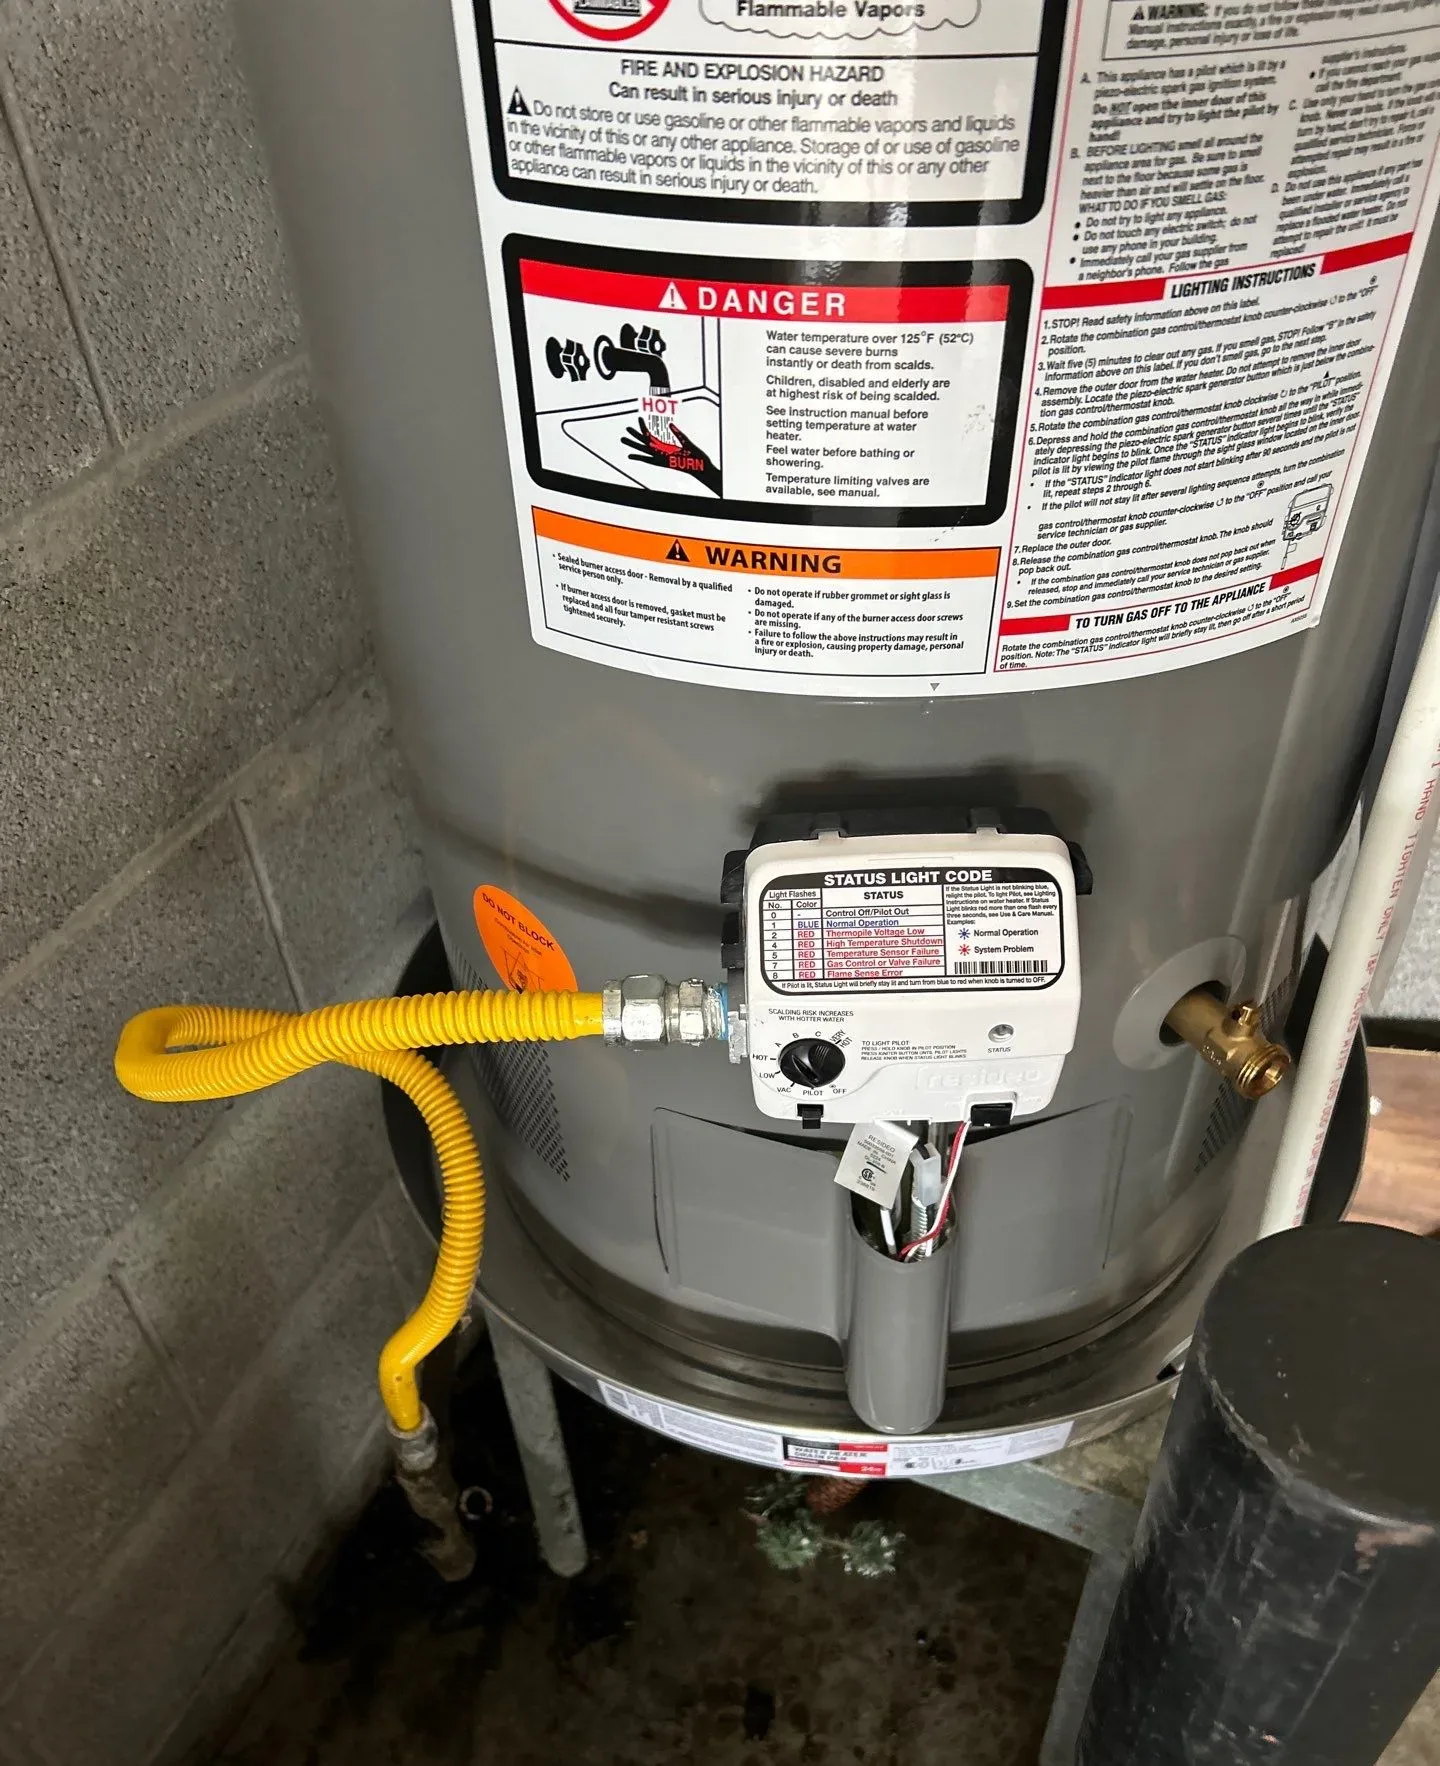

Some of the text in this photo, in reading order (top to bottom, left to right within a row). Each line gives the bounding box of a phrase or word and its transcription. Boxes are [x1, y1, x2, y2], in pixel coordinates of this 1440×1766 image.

[736, 0, 925, 20] Flammable Vapors
[621, 60, 884, 81] FIRE AND EXPLOSION HAZARD
[608, 82, 897, 109] Can result in serious injury or death
[1171, 262, 1316, 299] LIGHTING INSTRUCTIONS
[698, 286, 846, 317] DANGER
[766, 330, 973, 345] Water temperature over 125°F (52°C)
[766, 345, 898, 356] can cause severe burns
[766, 357, 934, 370] instantly or death from scalds.
[765, 375, 815, 388] Children,
[818, 377, 865, 387] disabled
[868, 378, 889, 388] and
[891, 378, 929, 390] elderly
[765, 388, 939, 403] at highest risk of being scalded.
[641, 396, 679, 415] HOT
[766, 405, 928, 418] See instruction manual before
[766, 419, 917, 432] setting temperature at water
[766, 430, 801, 440] heater.
[766, 444, 787, 454] Feel
[790, 447, 820, 456] water
[822, 447, 856, 457] before
[859, 447, 900, 459] bathing
[668, 455, 705, 471] BURN
[765, 456, 823, 470] showering.
[765, 473, 830, 486] Temperature
[833, 475, 872, 487] limiting
[875, 476, 909, 485] valves
[765, 485, 879, 497] available, see manual.
[705, 545, 841, 575] WARNING
[1018, 563, 1071, 575] pop back out.
[754, 586, 765, 595] Do
[766, 588, 780, 596] not
[781, 590, 812, 598] operate
[814, 590, 820, 598] if
[821, 590, 849, 599] rubber
[850, 592, 888, 601] grommet
[899, 591, 920, 601] sight
[921, 591, 942, 601] glass
[943, 591, 950, 599] is
[1076, 582, 1265, 629] TO TURN GAS OFF TO THE APPLIANCE
[997, 661, 1008, 670] of
[1376, 778, 1436, 940] HAND TIGHTEN ONLY
[824, 870, 992, 886] STATUS LIGHT CODE
[769, 890, 817, 900] Light Flashes
[864, 891, 903, 900] STATUS
[825, 907, 909, 917] Control Off/Pilot Out
[482, 892, 495, 908] DO
[497, 905, 516, 924] NOT
[518, 921, 555, 951] BLOCK
[826, 919, 899, 928] Normal Operation
[826, 929, 873, 938] Thermopile
[874, 928, 905, 937] Voltage
[973, 929, 1039, 937] Normal Operation
[826, 939, 845, 949] High
[847, 939, 900, 948] Temperature
[974, 945, 1034, 954] System Problem
[827, 950, 876, 958] Temperature
[827, 960, 844, 968] Gas
[828, 970, 852, 978] Flame
[768, 1008, 800, 1017] SCALDING
